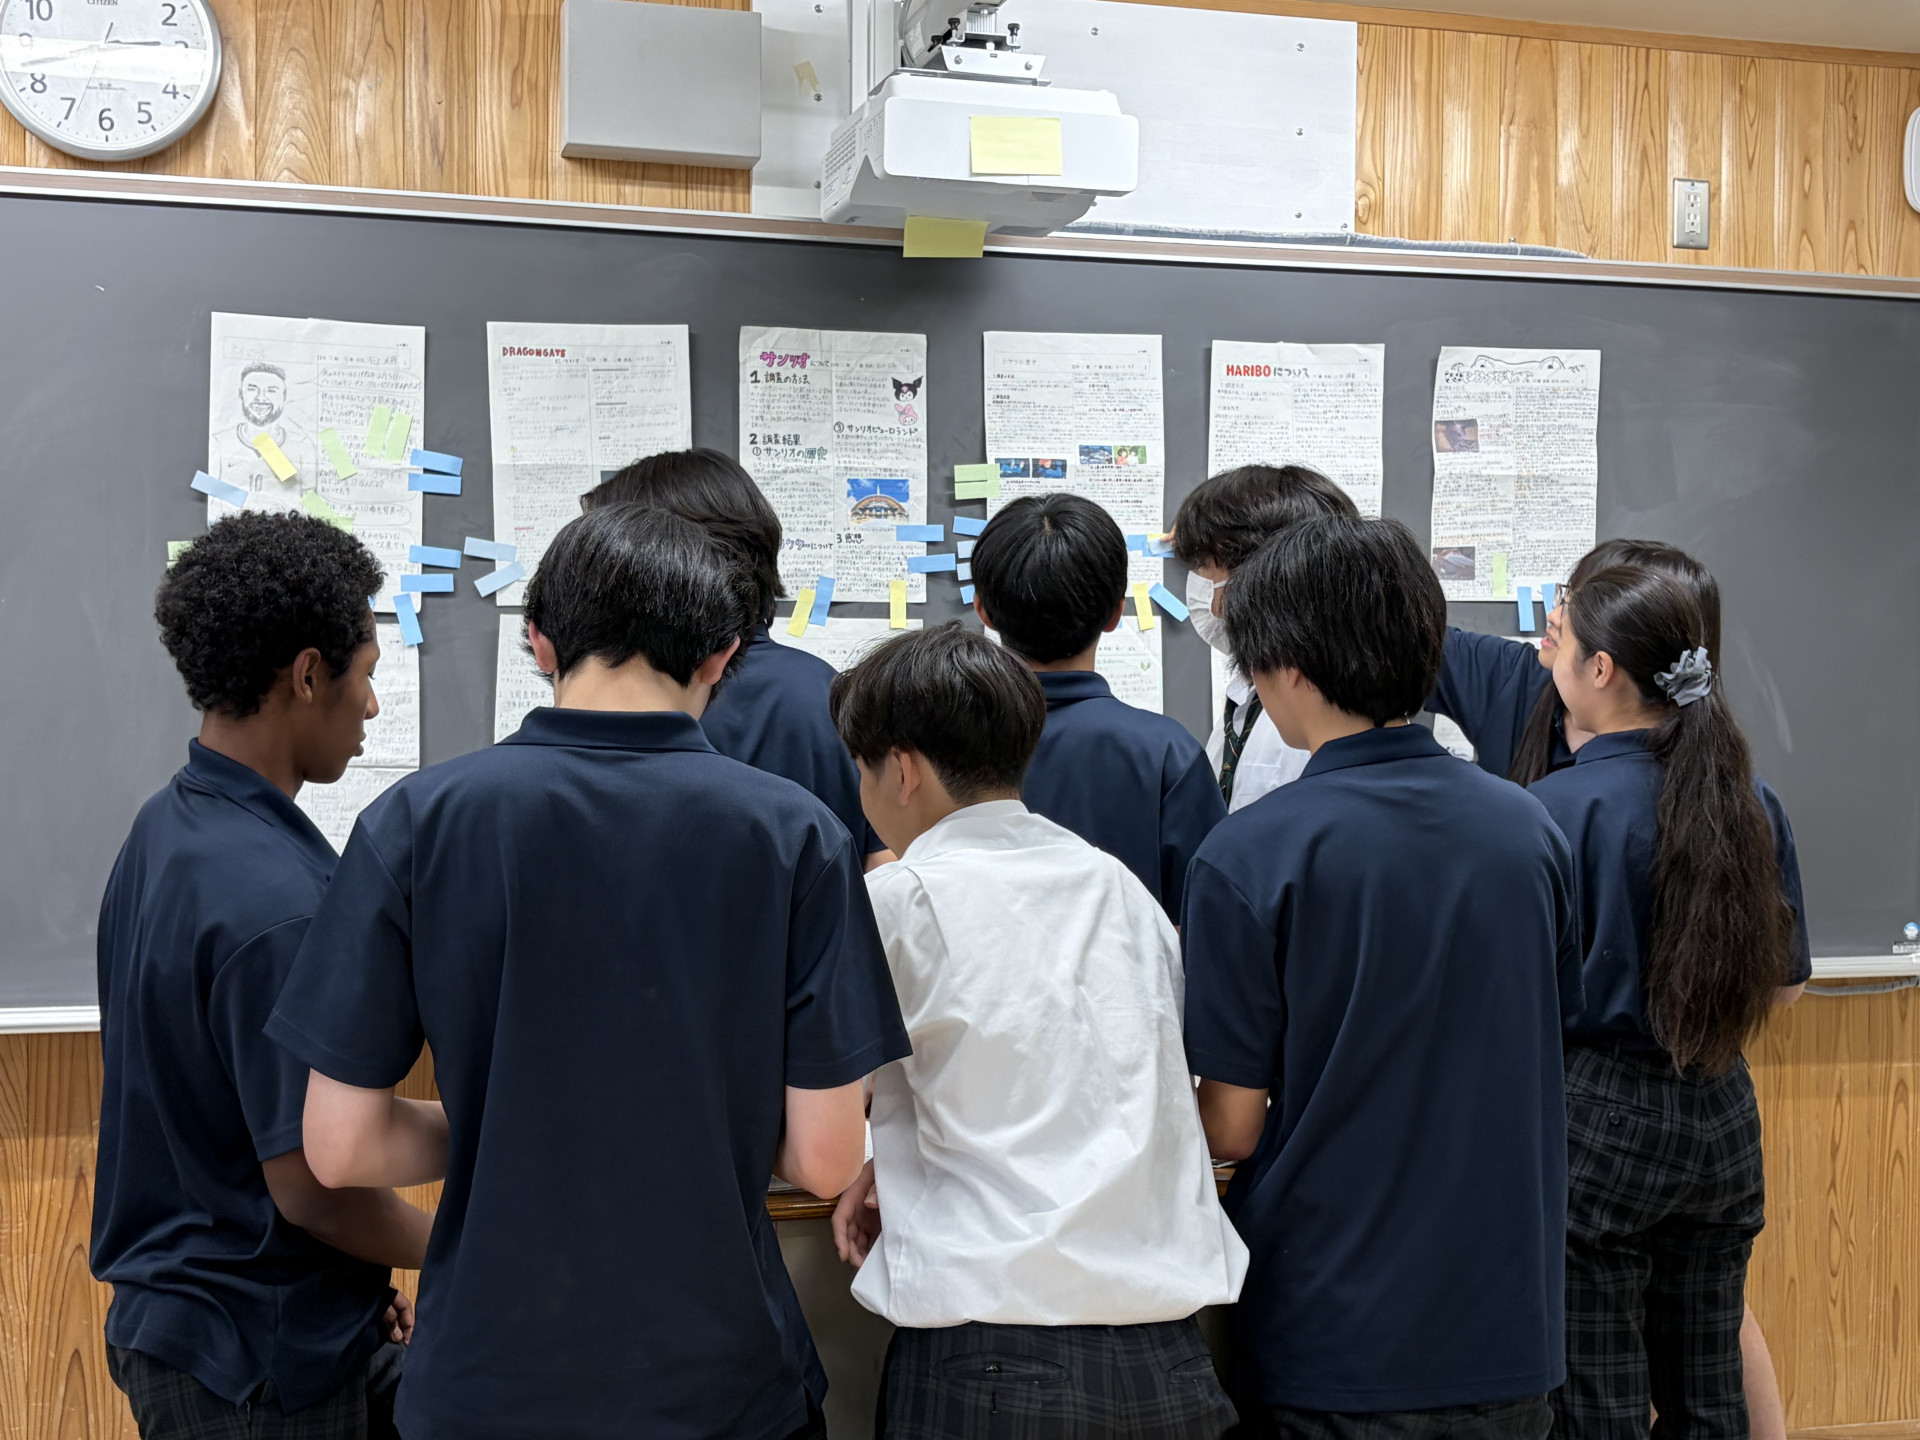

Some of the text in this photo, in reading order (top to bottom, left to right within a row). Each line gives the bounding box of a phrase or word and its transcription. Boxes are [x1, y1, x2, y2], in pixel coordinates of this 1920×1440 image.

[26, 0, 53, 21] 10
[161, 3, 178, 27] 2
[30, 72, 47, 94] 8
[162, 79, 179, 100] 4
[60, 97, 76, 121] 7
[98, 108, 115, 132] 6
[137, 101, 152, 125] 5
[502, 346, 566, 358] DRAGONGATE
[1226, 364, 1310, 378] HARIBO について
